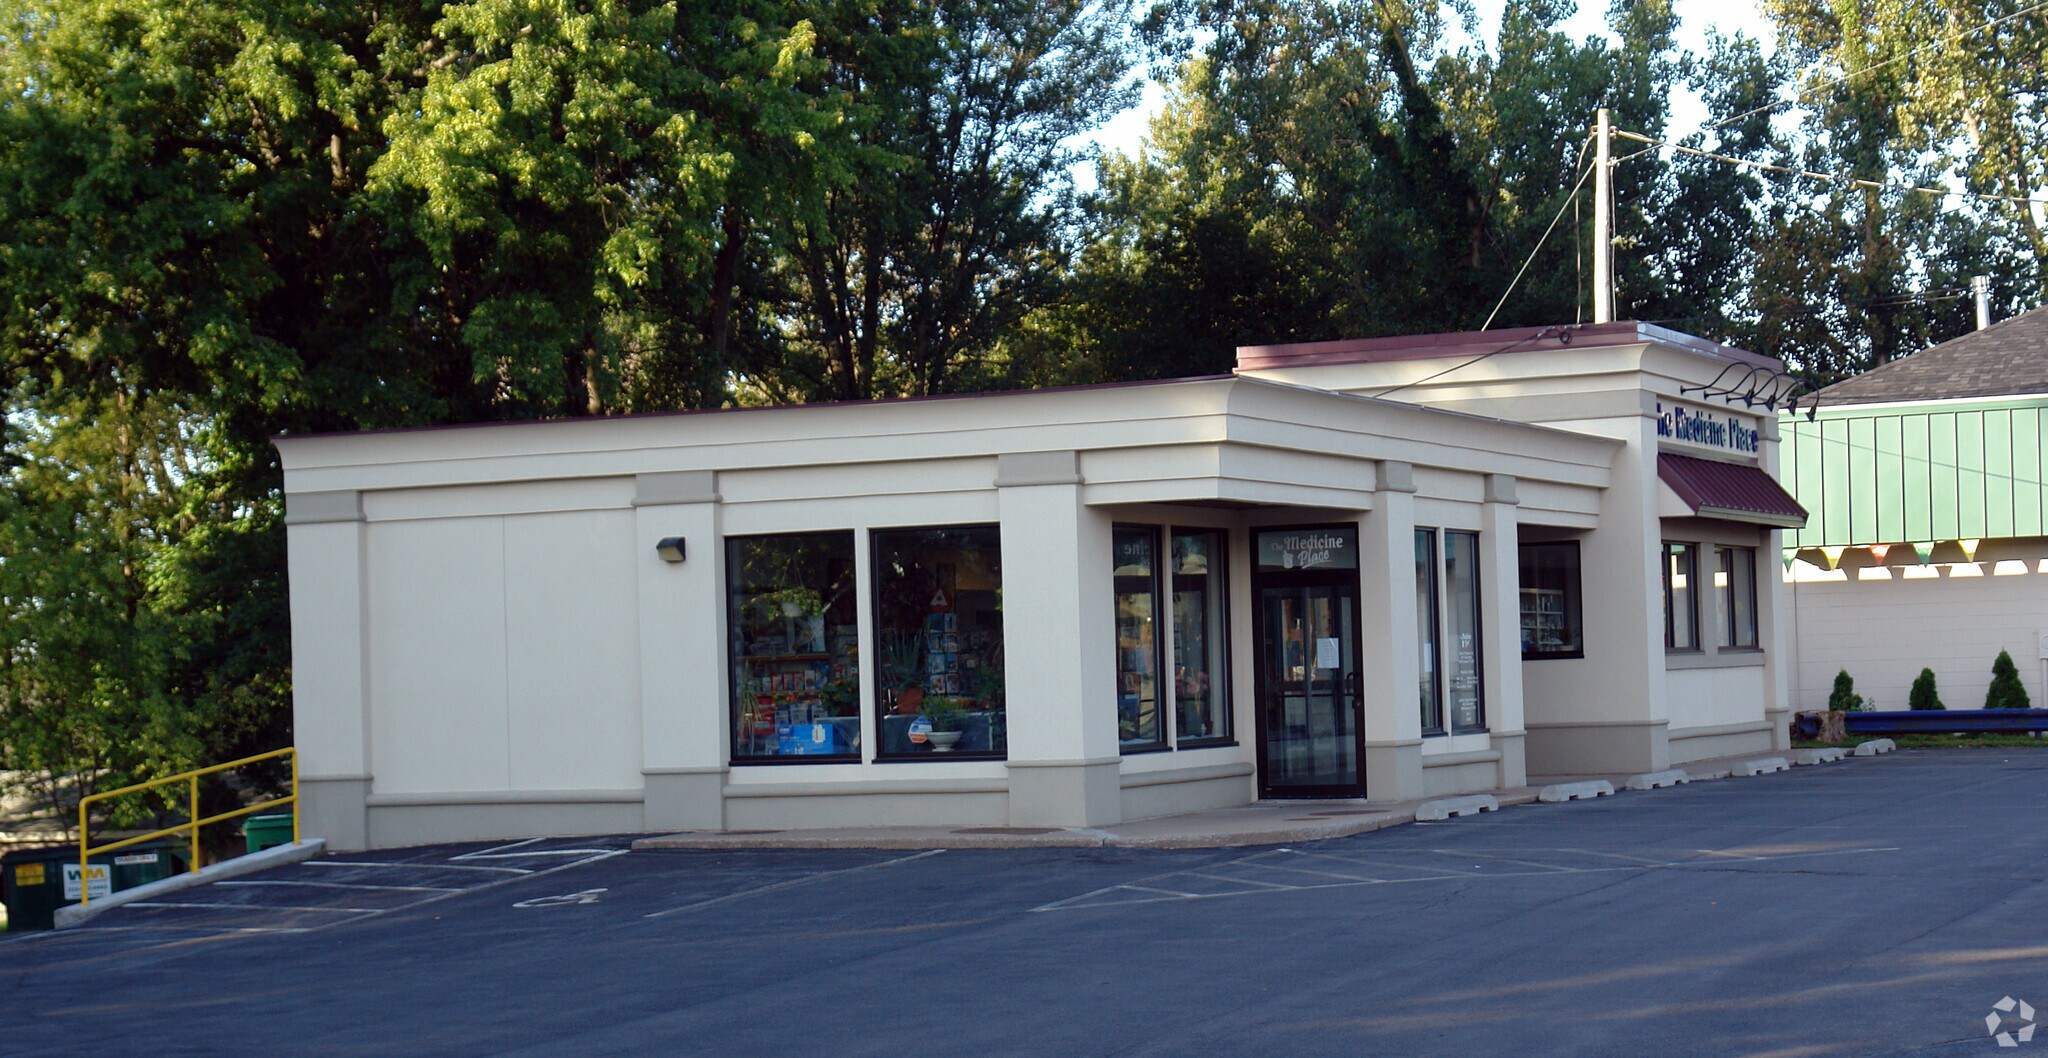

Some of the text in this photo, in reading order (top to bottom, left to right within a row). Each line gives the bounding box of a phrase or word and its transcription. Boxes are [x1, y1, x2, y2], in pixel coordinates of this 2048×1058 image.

[1656, 402, 1759, 453] he Medicine Place
[1284, 533, 1344, 551] Medicine
[1297, 547, 1330, 566] Place
